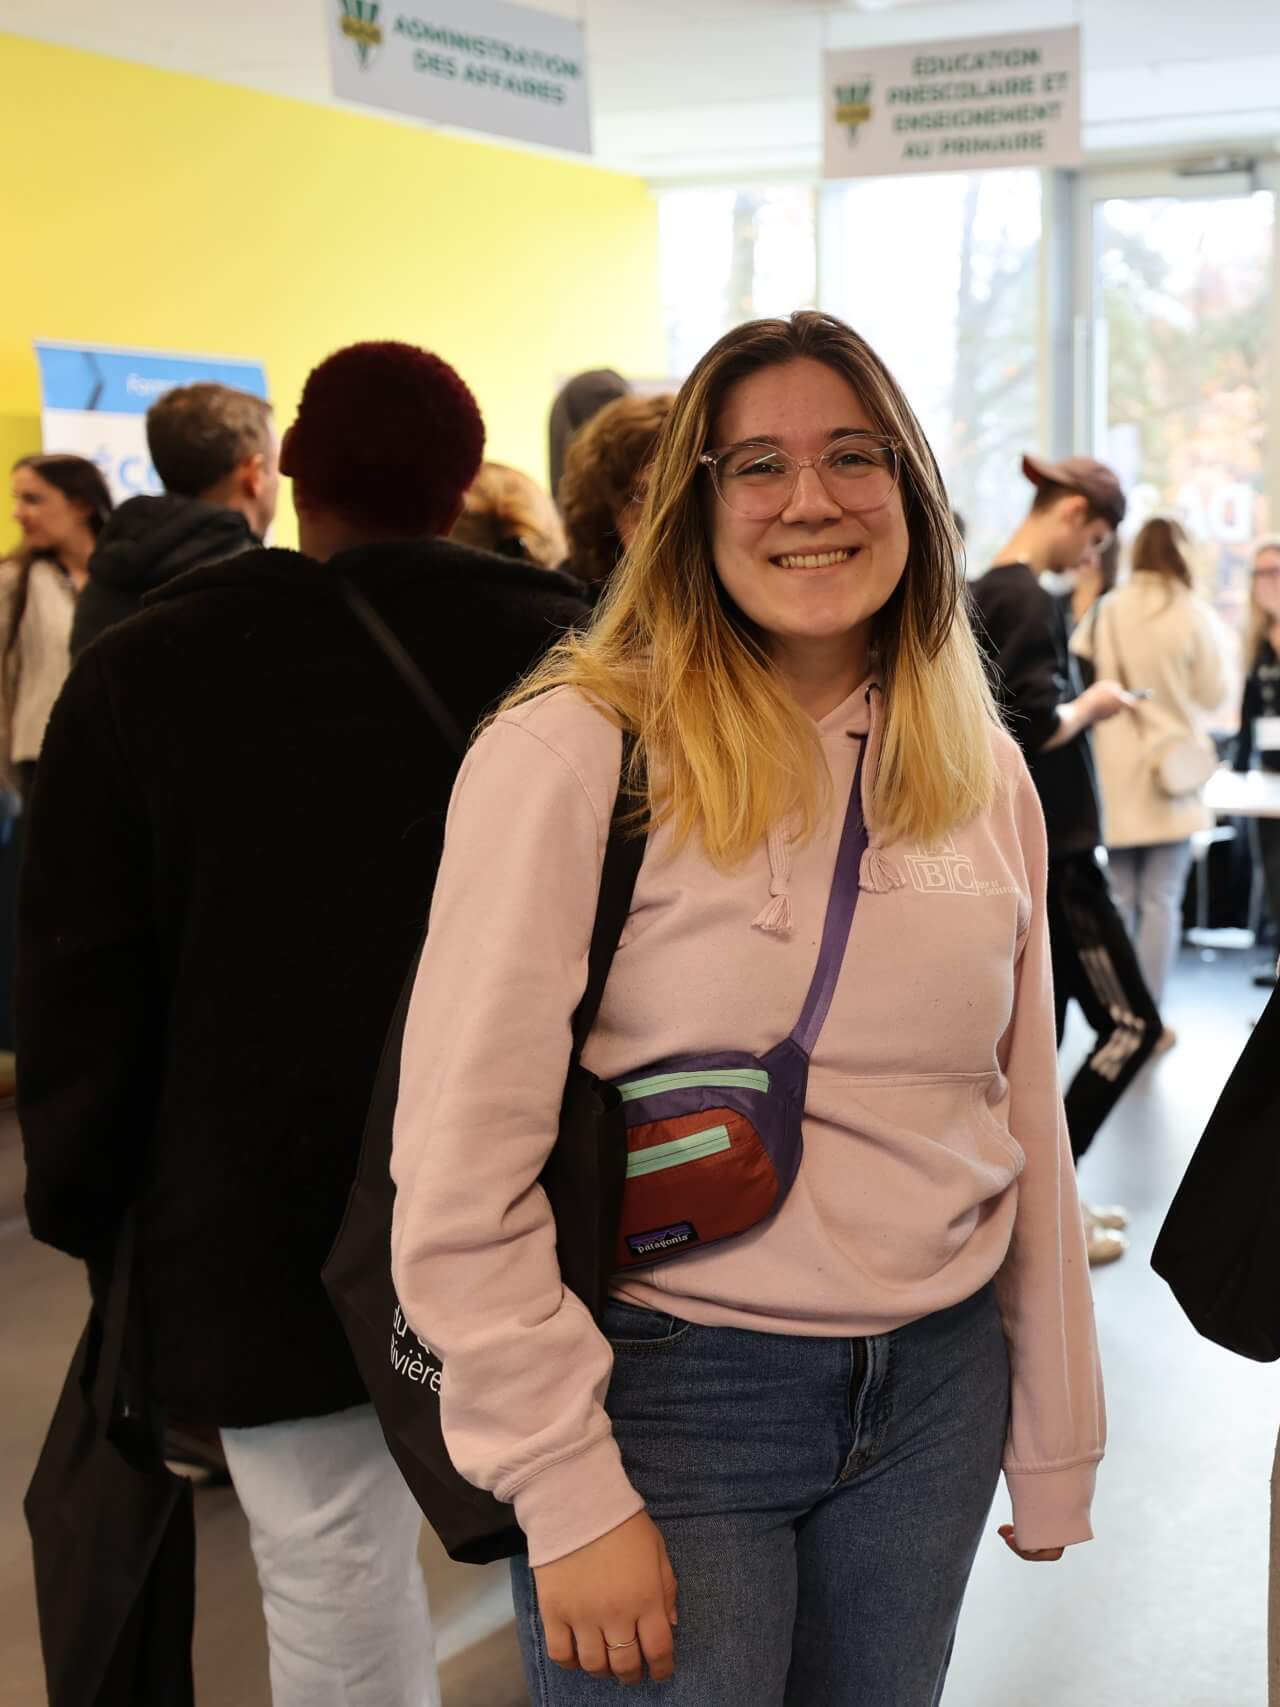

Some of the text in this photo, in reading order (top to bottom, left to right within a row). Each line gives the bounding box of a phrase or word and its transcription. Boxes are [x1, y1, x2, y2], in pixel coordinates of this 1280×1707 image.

[395, 15, 578, 77] ADMINISTRATION
[414, 49, 564, 103] DES AFFAIRES
[1043, 73, 1068, 93] ET
[894, 102, 1059, 132] ENSEIGNEMENT
[904, 132, 1043, 158] AU PRIMAIRE
[637, 1233, 689, 1254] patagonia
